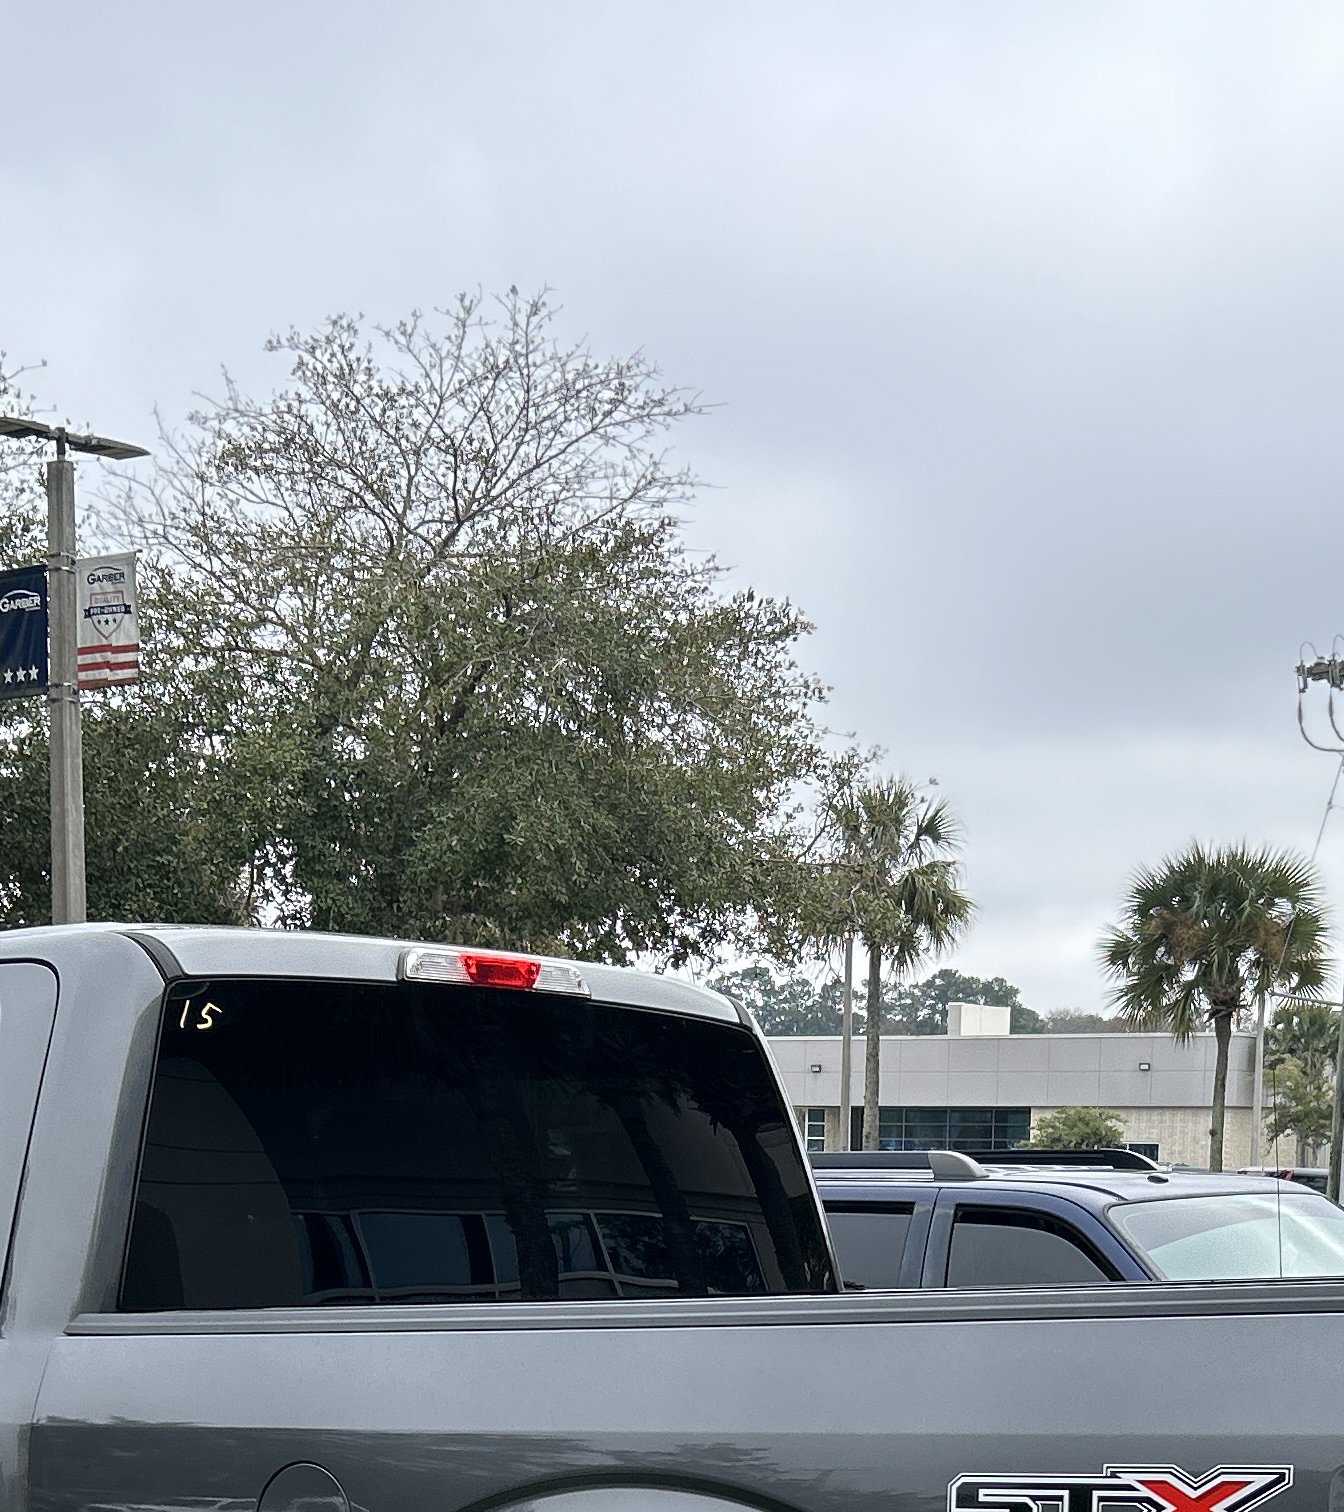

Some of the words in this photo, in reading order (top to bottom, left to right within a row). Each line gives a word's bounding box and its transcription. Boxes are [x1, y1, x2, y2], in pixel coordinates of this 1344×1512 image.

[87, 572, 125, 585] GARBER
[0, 597, 41, 612] GARBER
[179, 999, 223, 1030] 15
